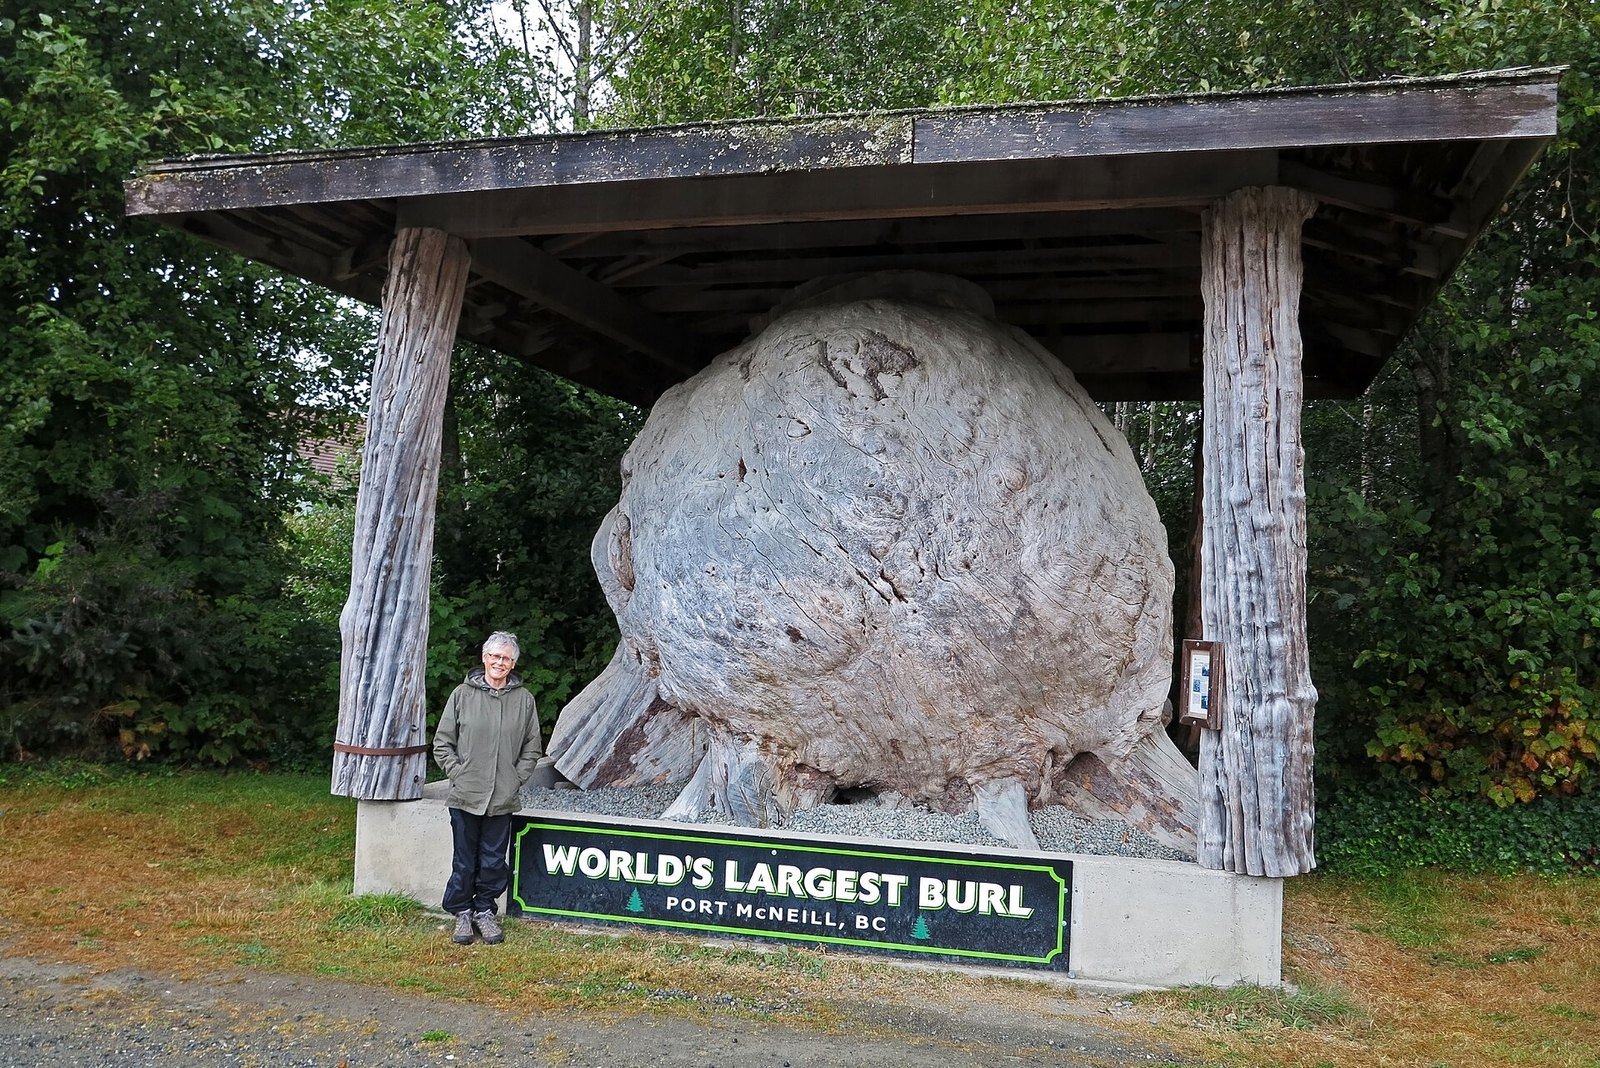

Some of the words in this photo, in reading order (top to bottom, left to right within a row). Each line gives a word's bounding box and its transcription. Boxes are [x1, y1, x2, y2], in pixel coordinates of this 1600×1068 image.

[542, 843, 714, 890] WORLD'S
[725, 860, 908, 907] LARGEST
[918, 876, 1035, 919] BURL
[666, 896, 728, 916] PORT
[736, 903, 845, 931] McNEILL,
[855, 915, 887, 932] BC
